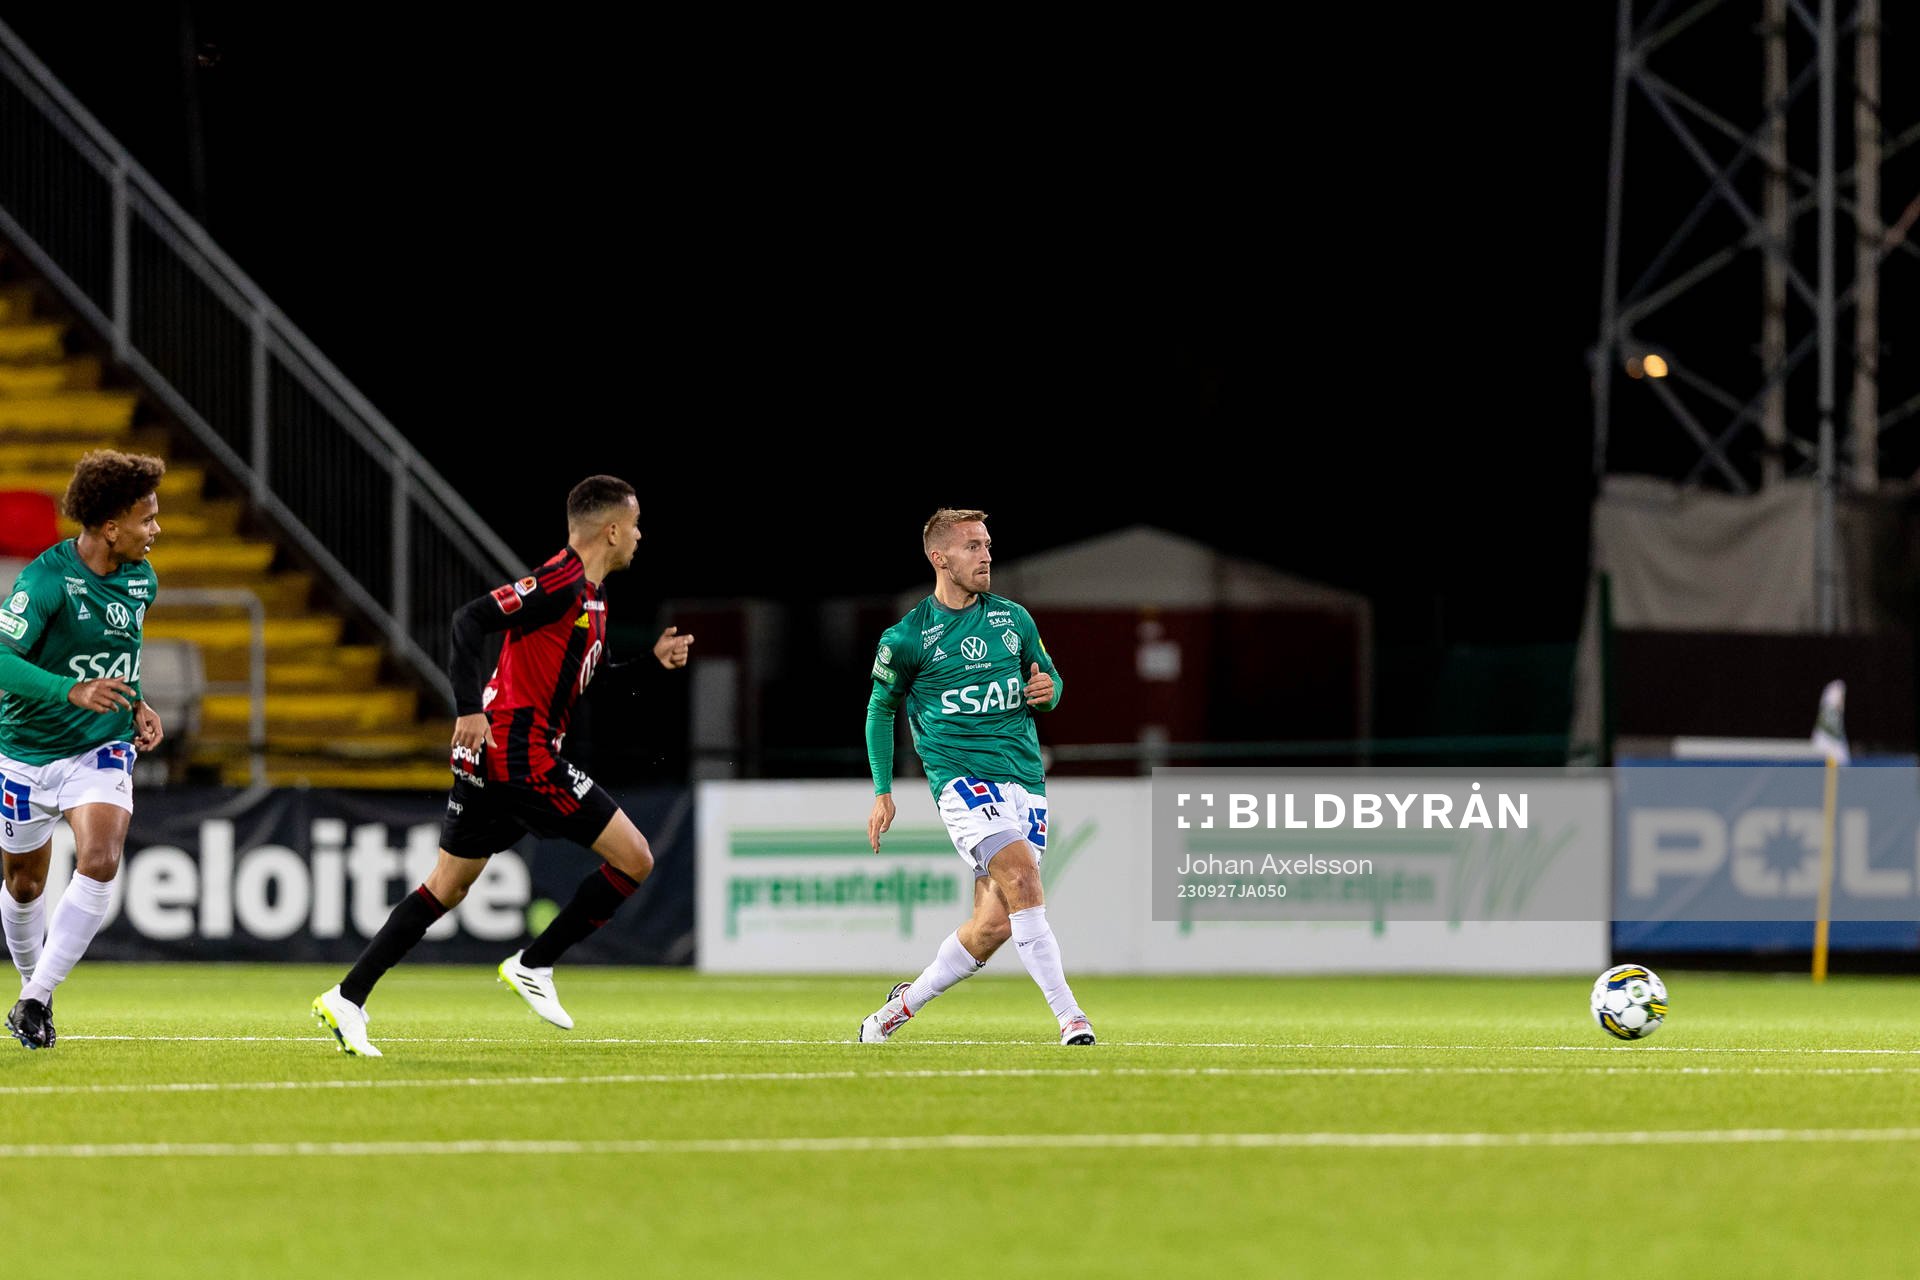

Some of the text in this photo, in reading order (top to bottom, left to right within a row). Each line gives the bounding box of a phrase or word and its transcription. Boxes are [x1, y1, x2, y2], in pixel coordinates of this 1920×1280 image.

[941, 677, 1021, 715] SSAB
[982, 805, 1001, 821] 14
[5, 821, 14, 837] 8
